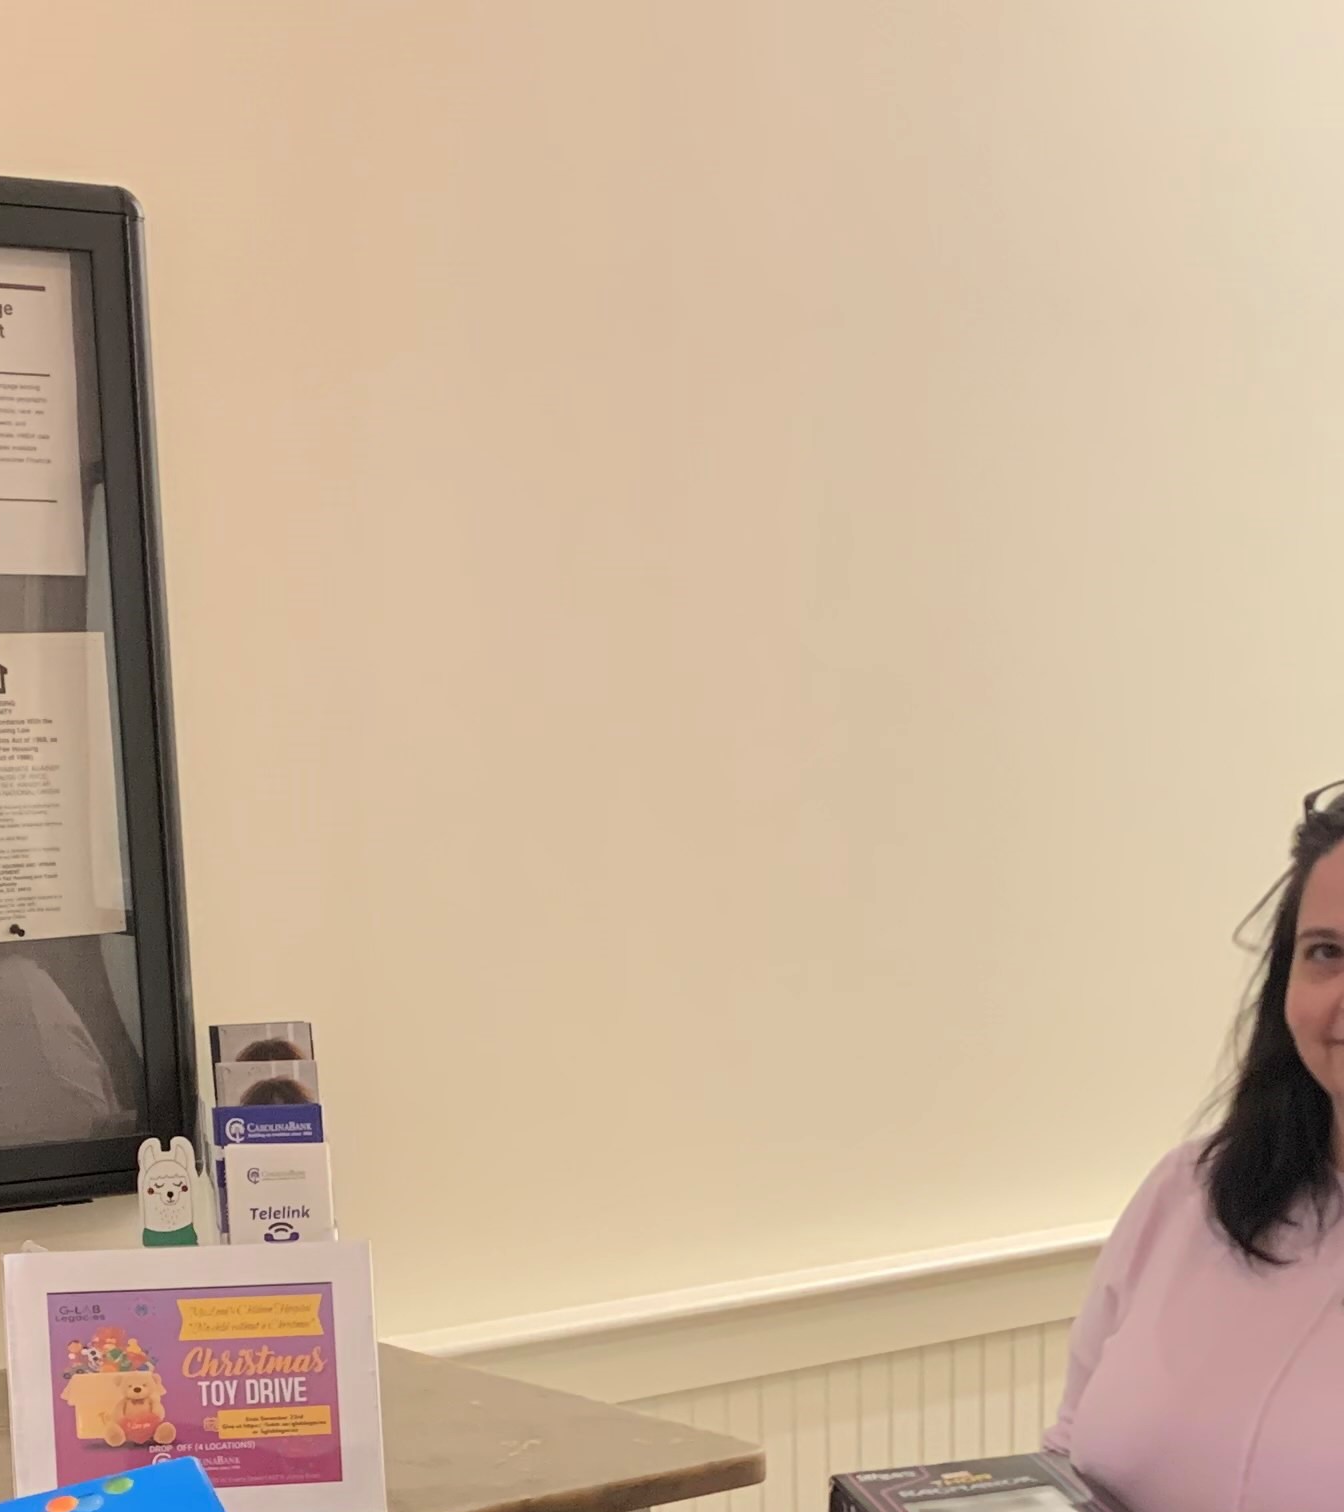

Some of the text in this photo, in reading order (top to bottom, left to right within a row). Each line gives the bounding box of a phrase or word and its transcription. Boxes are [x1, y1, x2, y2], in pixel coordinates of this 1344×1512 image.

[250, 1205, 310, 1220] Telelink
[59, 1304, 101, 1315] G-LAB
[181, 1344, 327, 1378] Christmas
[198, 1376, 307, 1406] TOY DRIVE
[149, 1441, 256, 1453] DROP OFF (4 LOCATIONS)
